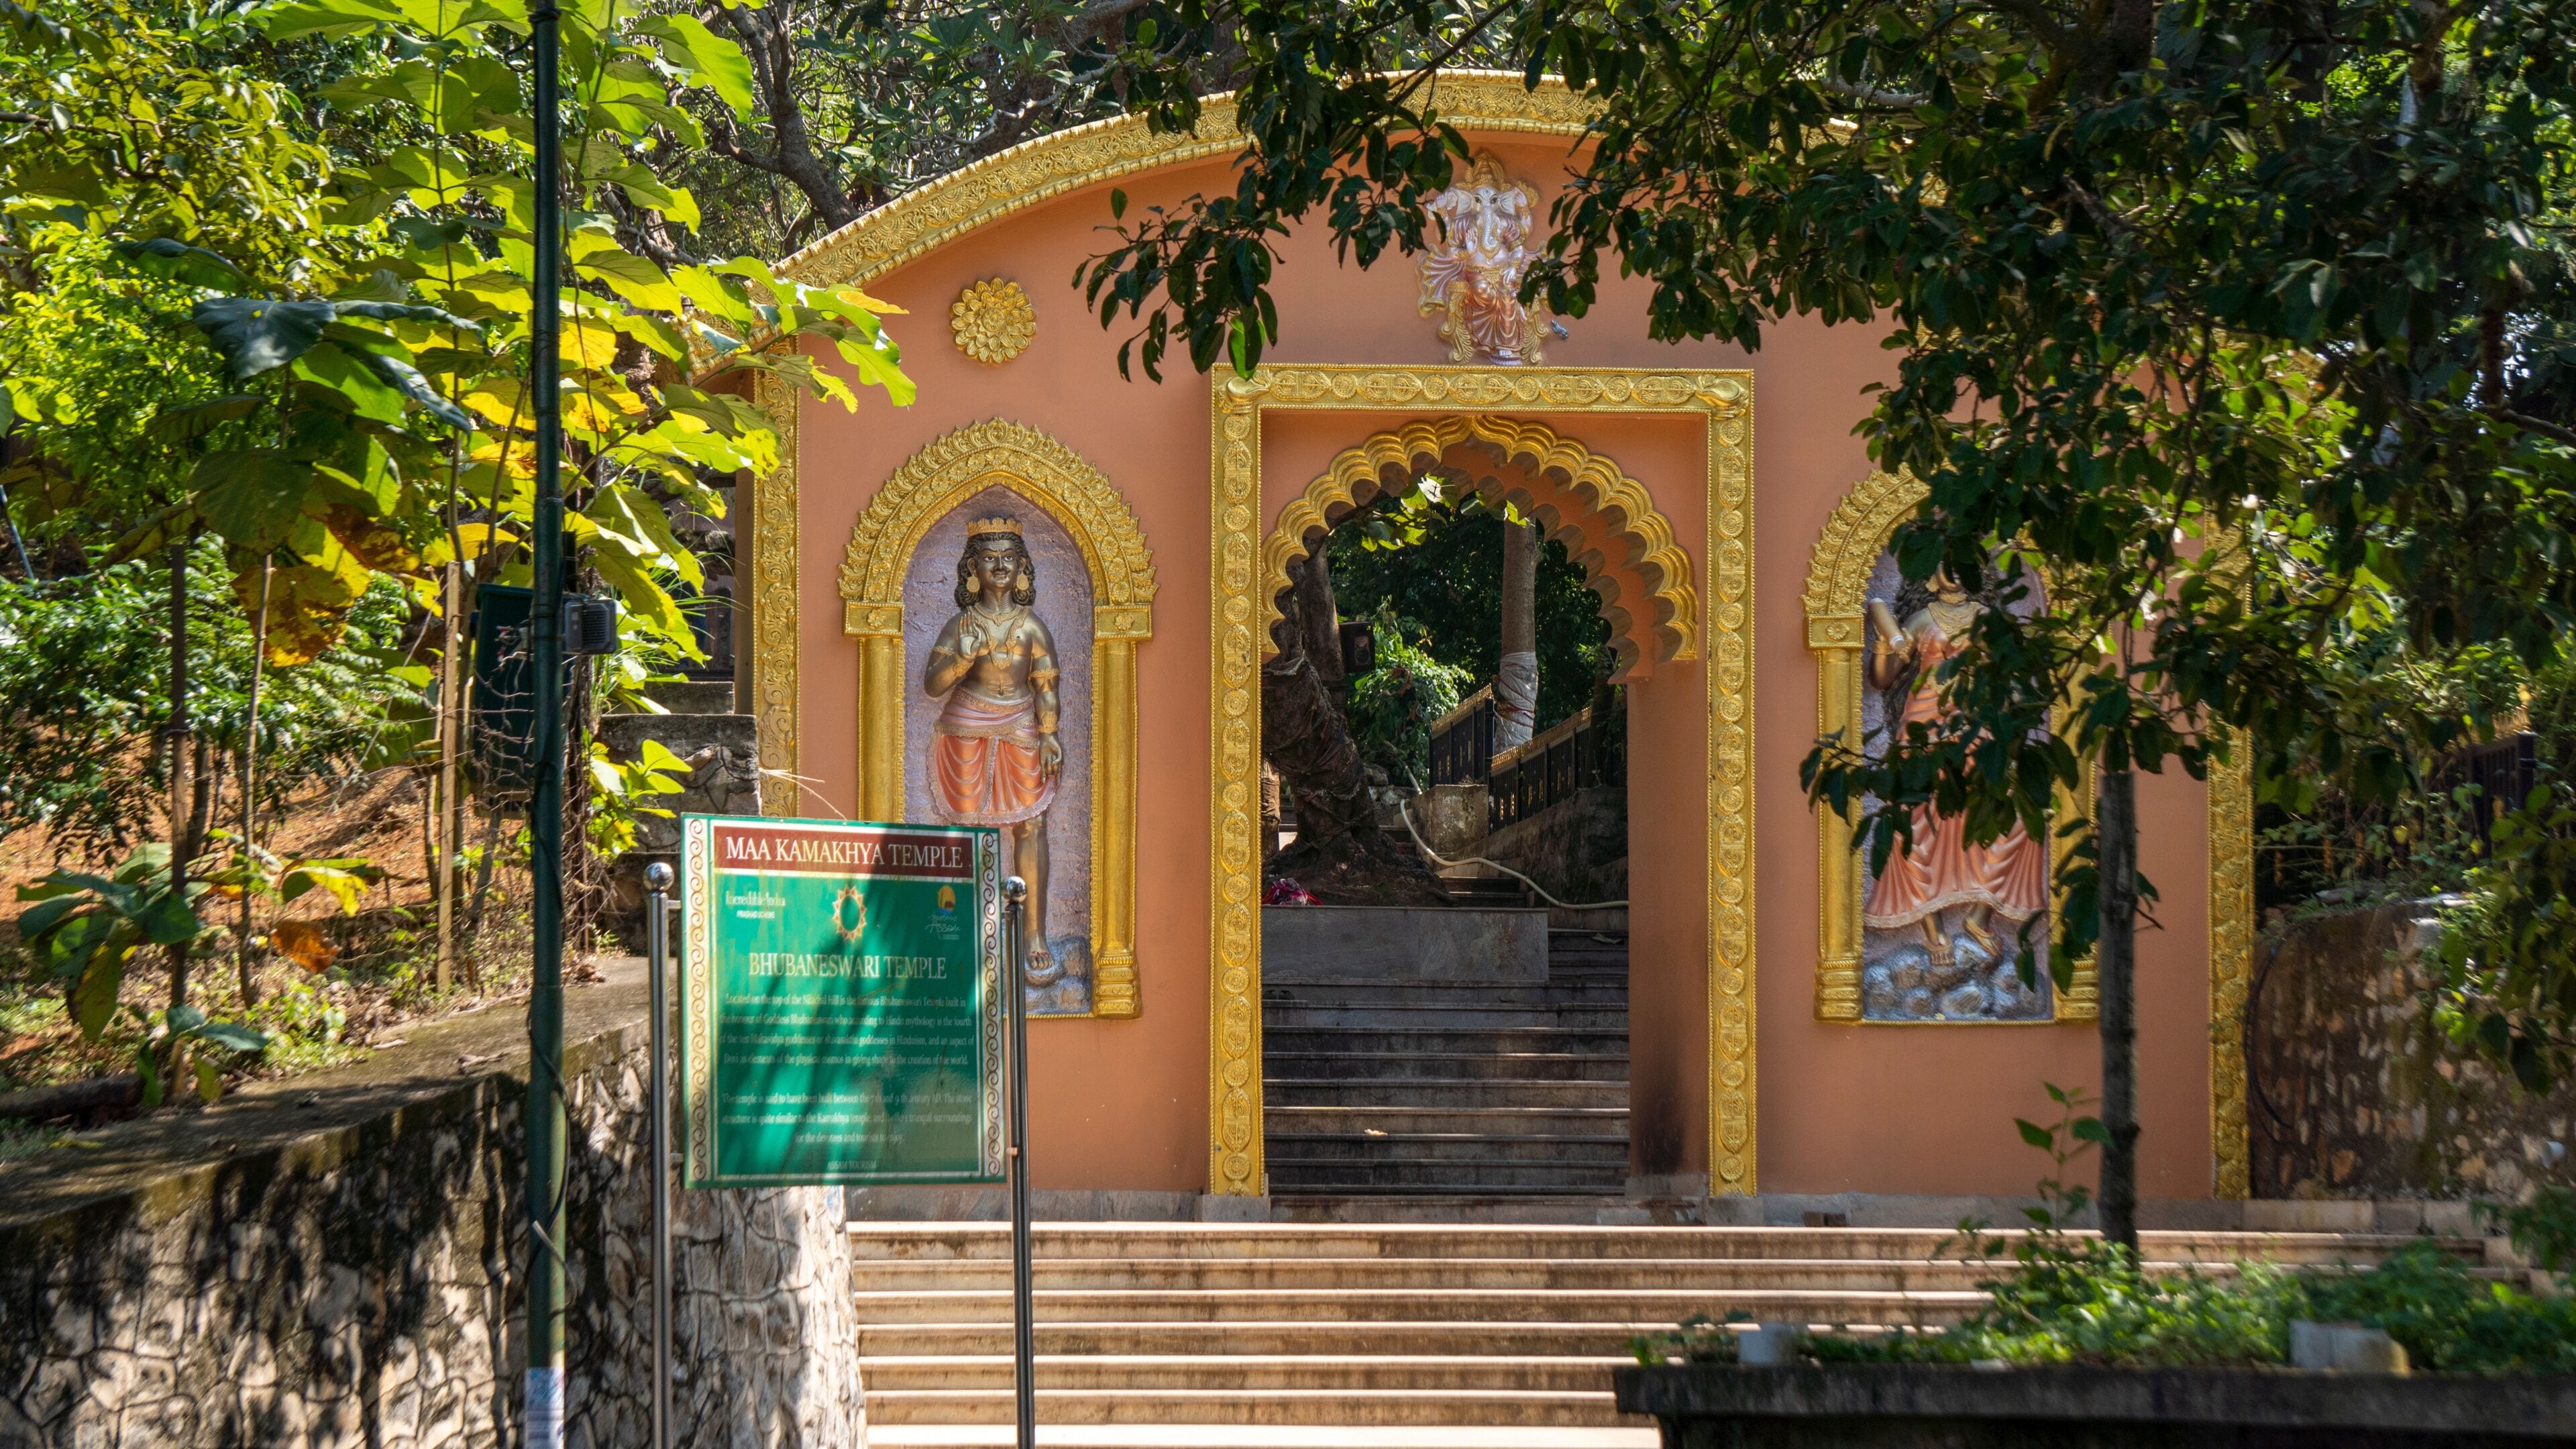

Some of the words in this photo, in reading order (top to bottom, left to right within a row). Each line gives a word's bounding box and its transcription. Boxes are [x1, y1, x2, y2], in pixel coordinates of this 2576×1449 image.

[726, 836, 771, 861] MAA
[775, 838, 883, 865] KAMAKHYA
[888, 843, 963, 869] TEMPLE
[749, 952, 880, 978] BHUBANESWARI
[883, 955, 947, 979] TEMPLE
[945, 997, 959, 1007] built
[960, 998, 966, 1007] in
[905, 1016, 936, 1028] mythology
[937, 1016, 942, 1026] is
[943, 1016, 953, 1026] the
[954, 1016, 971, 1026] fourth
[897, 1035, 927, 1046] Hinduism,
[928, 1035, 939, 1045] and
[949, 1036, 967, 1048] aspect
[968, 1035, 974, 1045] of
[908, 1055, 932, 1065] creation
